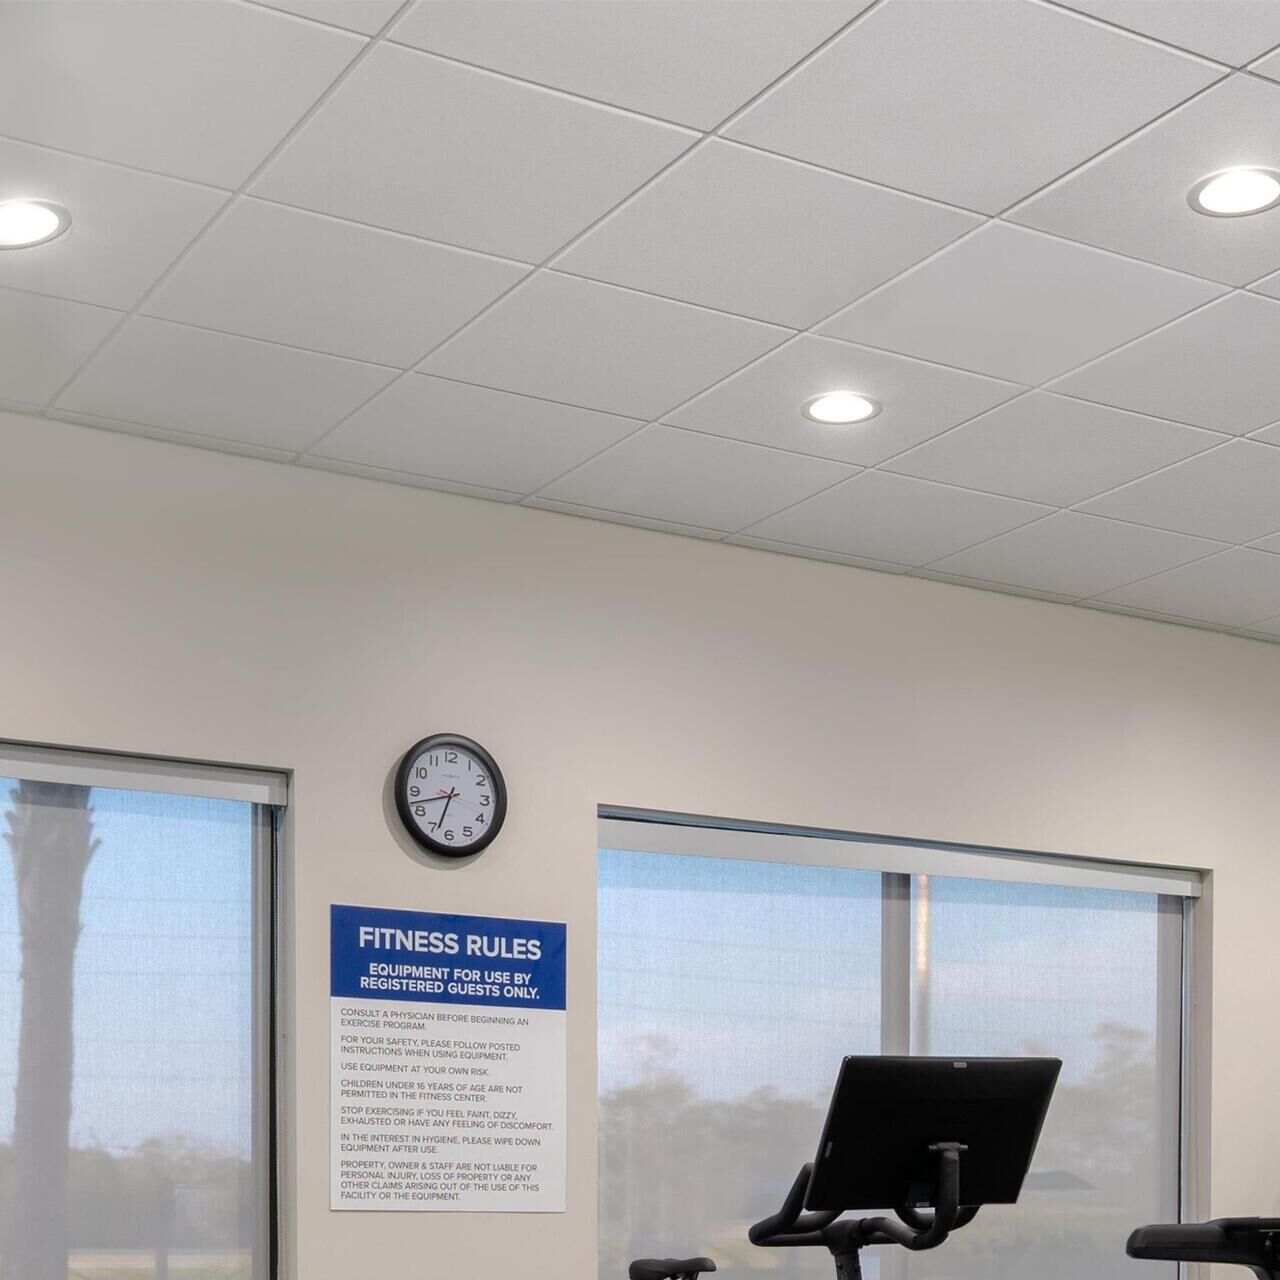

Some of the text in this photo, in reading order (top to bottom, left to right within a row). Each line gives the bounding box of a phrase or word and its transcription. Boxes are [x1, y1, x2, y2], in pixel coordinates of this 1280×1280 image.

[429, 755, 438, 767] 11
[445, 752, 458, 764] 12
[416, 767, 427, 779] 10
[476, 775, 486, 786] 2
[410, 785, 420, 797] 9
[480, 795, 490, 806] 3
[415, 806, 426, 817] 8
[475, 813, 485, 824] 4
[428, 822, 437, 833] 7
[462, 826, 473, 837] 5
[444, 830, 454, 840] 6
[359, 927, 541, 960] FITNESS RULES
[369, 963, 531, 985] EQUIPMENT FOR USE BY
[360, 977, 539, 999] REGISTERED GUESTS ONLY.
[340, 1008, 528, 1026] CONSULT A PHYSICIAN BEFORE BEGINNING AN
[341, 1019, 380, 1029] EXERCISE
[341, 1036, 358, 1044] FOR
[360, 1036, 384, 1045] YOUR
[421, 1039, 451, 1048] PLEASE
[453, 1041, 486, 1050] FOLLOW
[489, 1042, 520, 1051] POSTED
[341, 1046, 402, 1056] INSTRUCTIONS
[404, 1049, 429, 1058] WHEN
[432, 1050, 457, 1059] USING
[341, 1063, 357, 1071] USE
[360, 1064, 407, 1073] EQUIPMENT
[411, 1066, 420, 1074] AT
[423, 1067, 446, 1075] YOUR
[448, 1068, 468, 1076] OWN
[341, 1080, 522, 1094] CHILDREN UNDER 16 YEARS OF AGE ARE NOT
[341, 1090, 387, 1100] PERMITTED
[389, 1092, 398, 1100] IN
[400, 1092, 416, 1100] THE
[419, 1093, 451, 1102] FITNESS
[341, 1106, 363, 1115] STOP
[365, 1107, 414, 1117] EXERCISING
[417, 1109, 423, 1117] IF
[426, 1109, 443, 1118] YOU
[446, 1110, 464, 1118] FEEL
[341, 1117, 391, 1126] EXHAUSTED
[393, 1118, 406, 1126] OR
[408, 1119, 430, 1127] HAVE
[432, 1120, 450, 1128] ANY
[452, 1120, 485, 1129] FEELING
[487, 1121, 498, 1129] OF
[341, 1134, 349, 1142] IN
[352, 1134, 368, 1142] THE
[370, 1135, 409, 1143] INTEREST
[462, 1137, 491, 1145] PLEASE
[494, 1137, 512, 1145] WIPE
[515, 1138, 540, 1146] DOWN
[341, 1144, 389, 1153] EQUIPMENT
[388, 1162, 419, 1170] OWNER
[455, 1163, 471, 1171] ARE
[474, 1163, 490, 1171] NOT
[493, 1164, 518, 1172] LIABLE
[521, 1164, 537, 1172] FOR
[341, 1171, 384, 1180] PERSONAL
[443, 1173, 454, 1181] OF
[457, 1173, 498, 1181] PROPERTY
[514, 1174, 531, 1182] ANY
[340, 1182, 369, 1190] OTHER
[371, 1182, 403, 1190] CLAIMS
[404, 1182, 437, 1190] ARISING
[440, 1183, 457, 1191] OUT
[459, 1183, 471, 1191] OF
[473, 1183, 488, 1191] THE
[521, 1184, 539, 1192] THIS
[341, 1192, 376, 1200] FACILITY
[379, 1192, 391, 1200] OR
